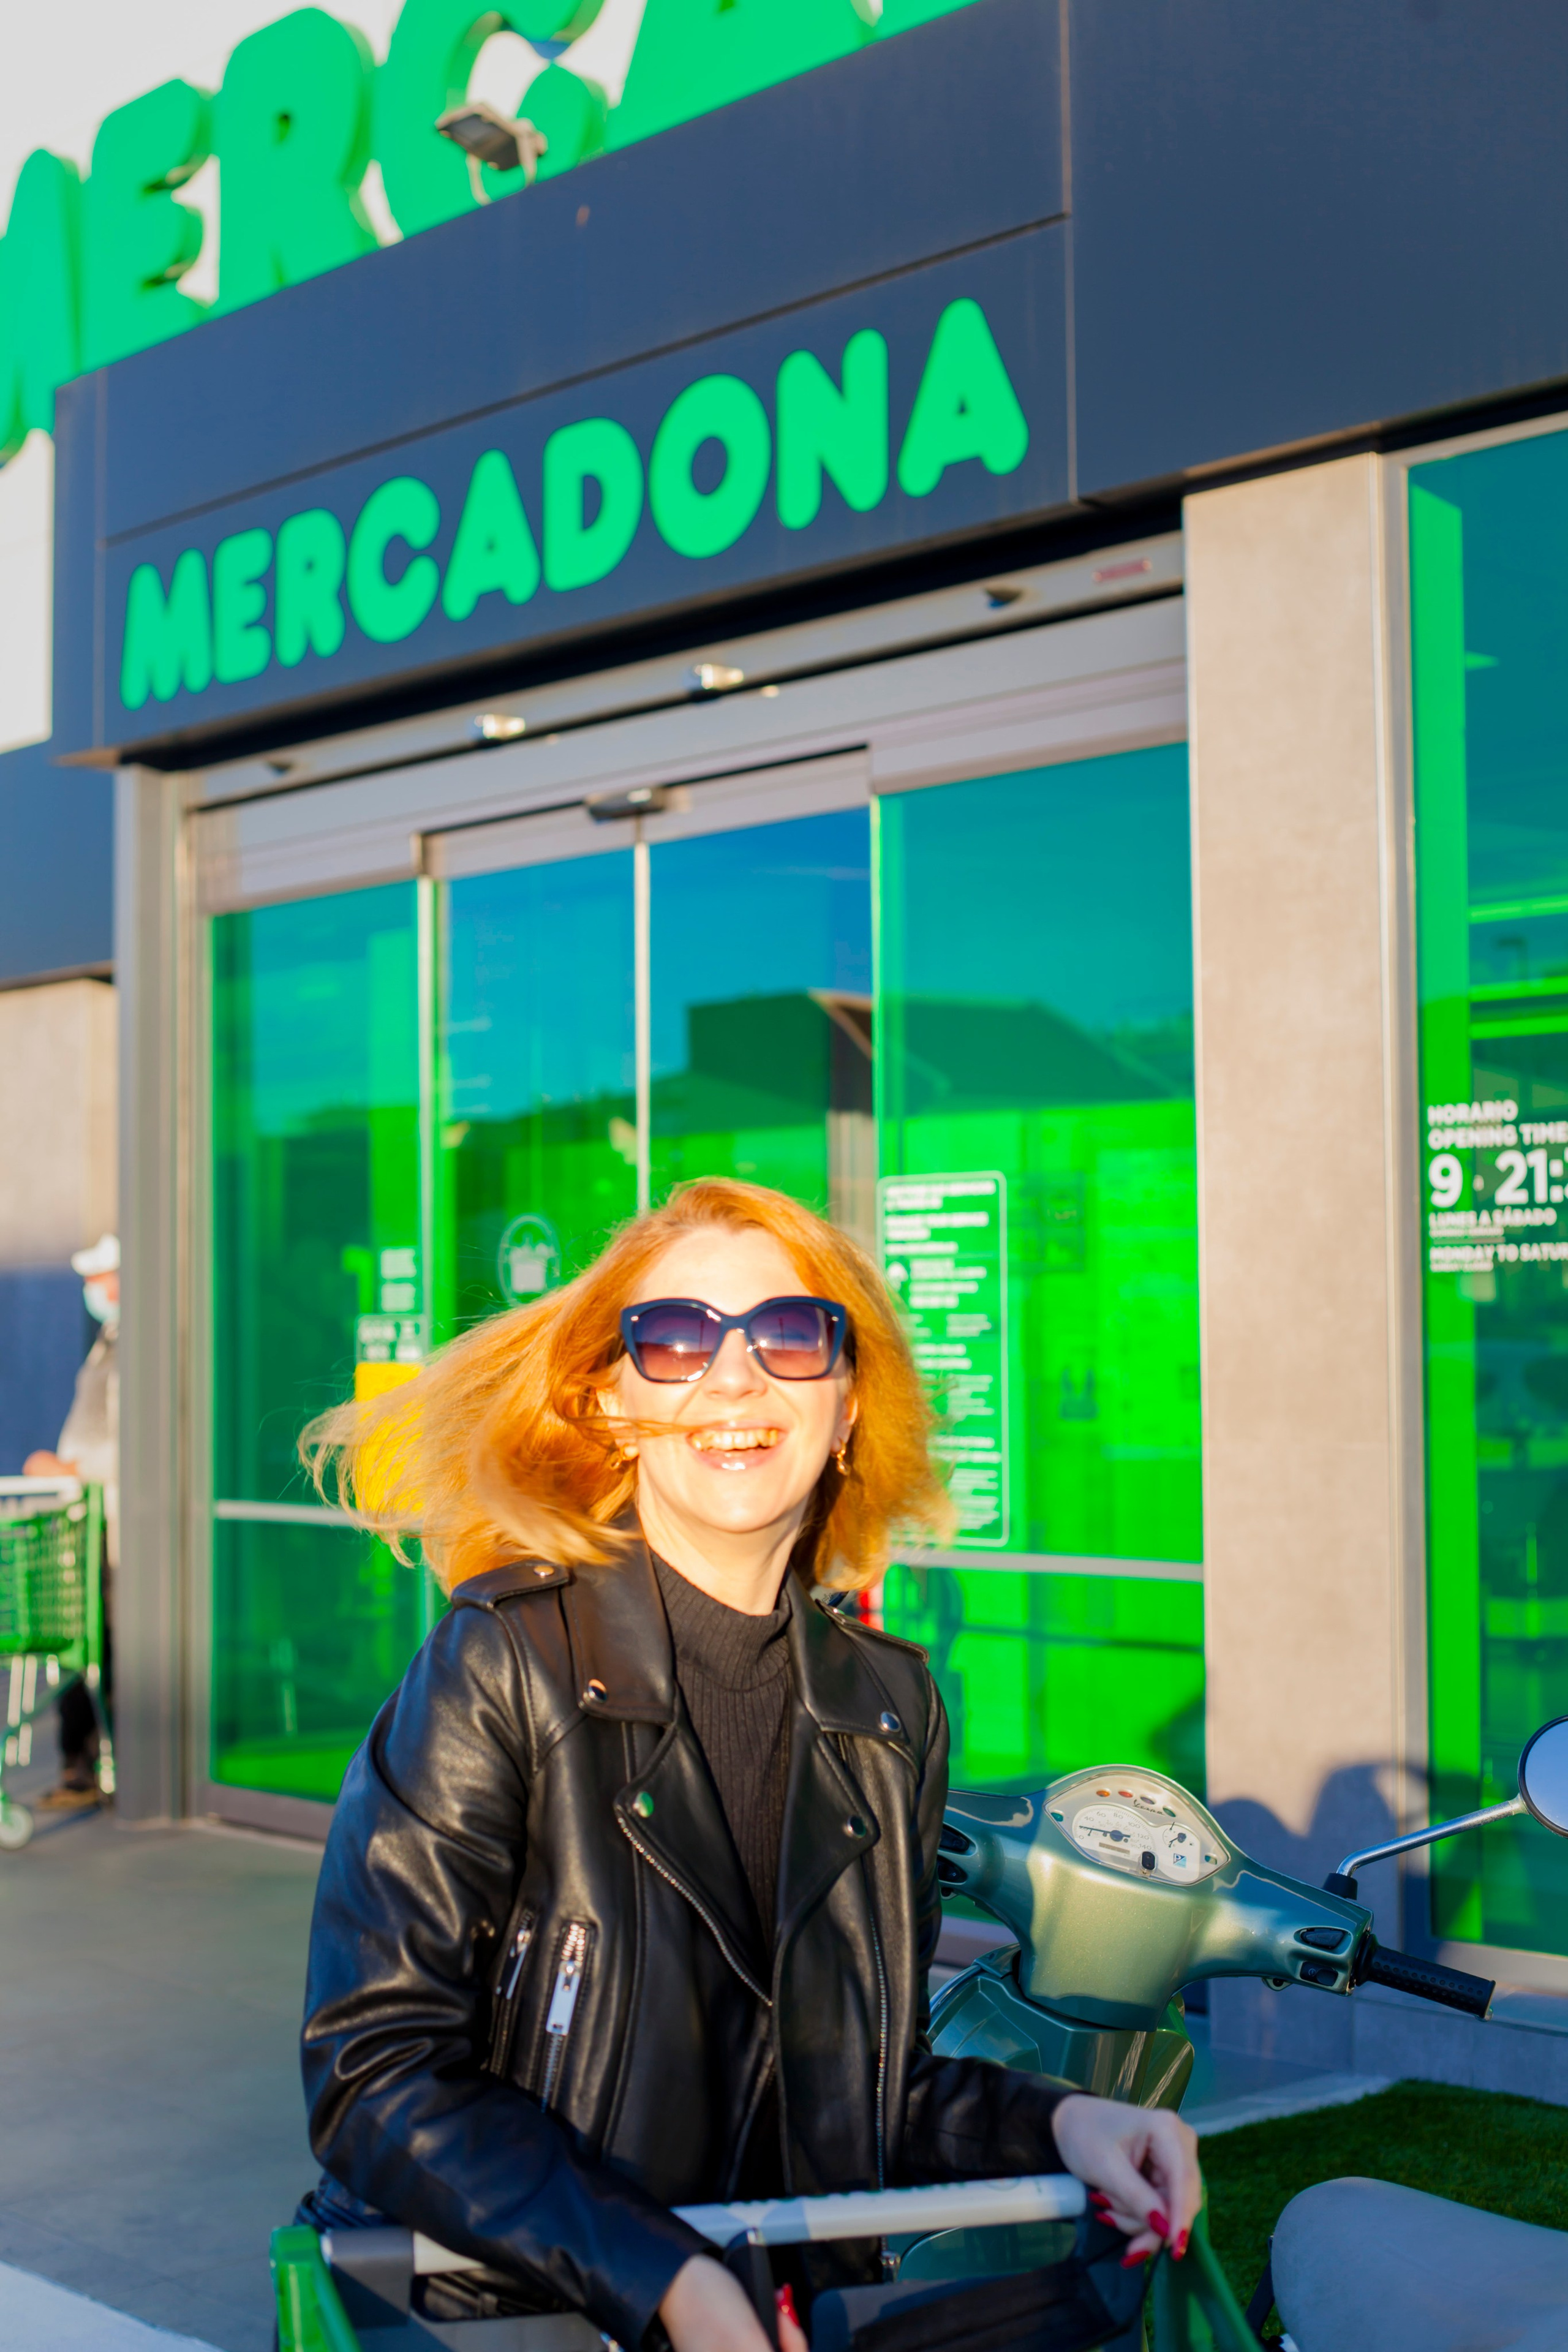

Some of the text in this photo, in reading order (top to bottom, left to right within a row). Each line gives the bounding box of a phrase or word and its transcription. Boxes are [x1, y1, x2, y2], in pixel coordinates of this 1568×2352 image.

[120, 298, 1030, 710] MERCADONA
[1429, 1153, 1463, 1208] 9
[1494, 1148, 1568, 1206] 21:
